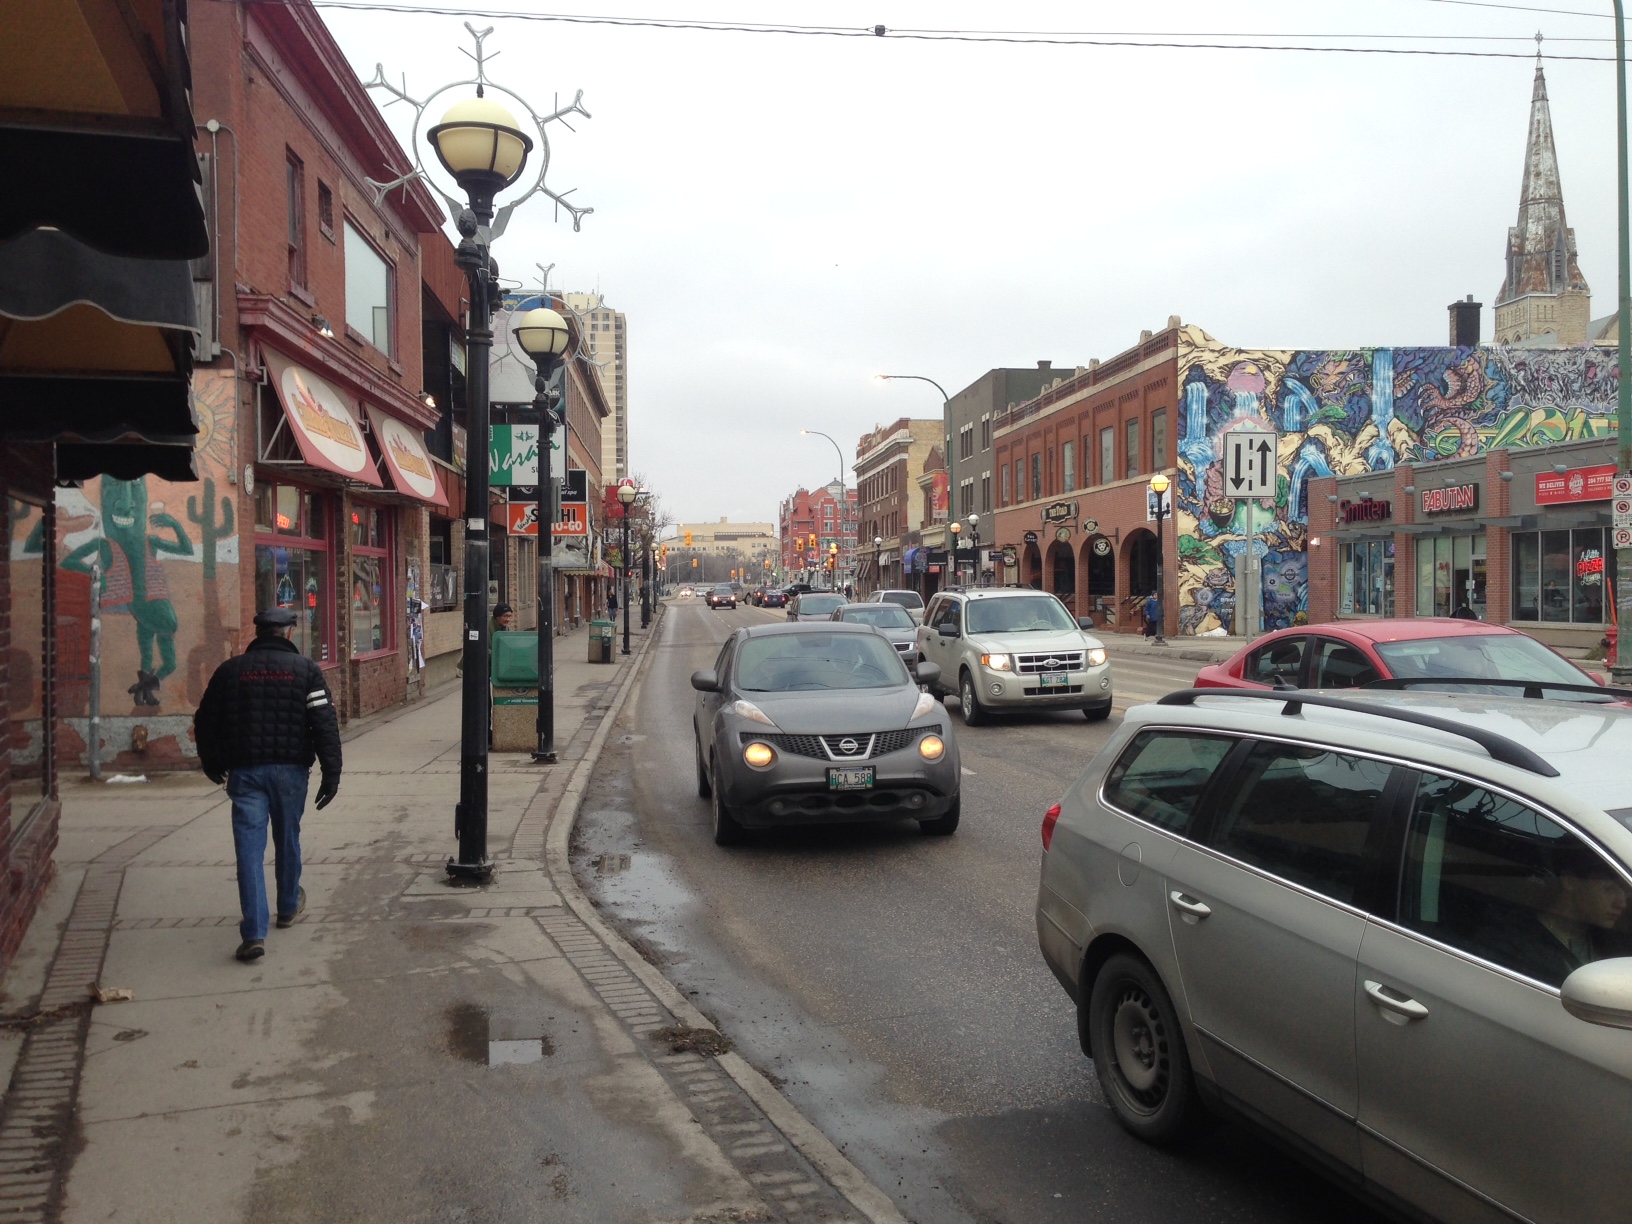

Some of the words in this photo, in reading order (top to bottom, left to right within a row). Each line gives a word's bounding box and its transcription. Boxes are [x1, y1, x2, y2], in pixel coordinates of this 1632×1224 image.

[488, 431, 561, 476] Wasai
[1422, 484, 1474, 512] FABUTAN
[531, 508, 577, 523] SHI
[1340, 497, 1389, 521] Smitten
[1577, 558, 1604, 577] PIZZA
[831, 774, 849, 785] HCA
